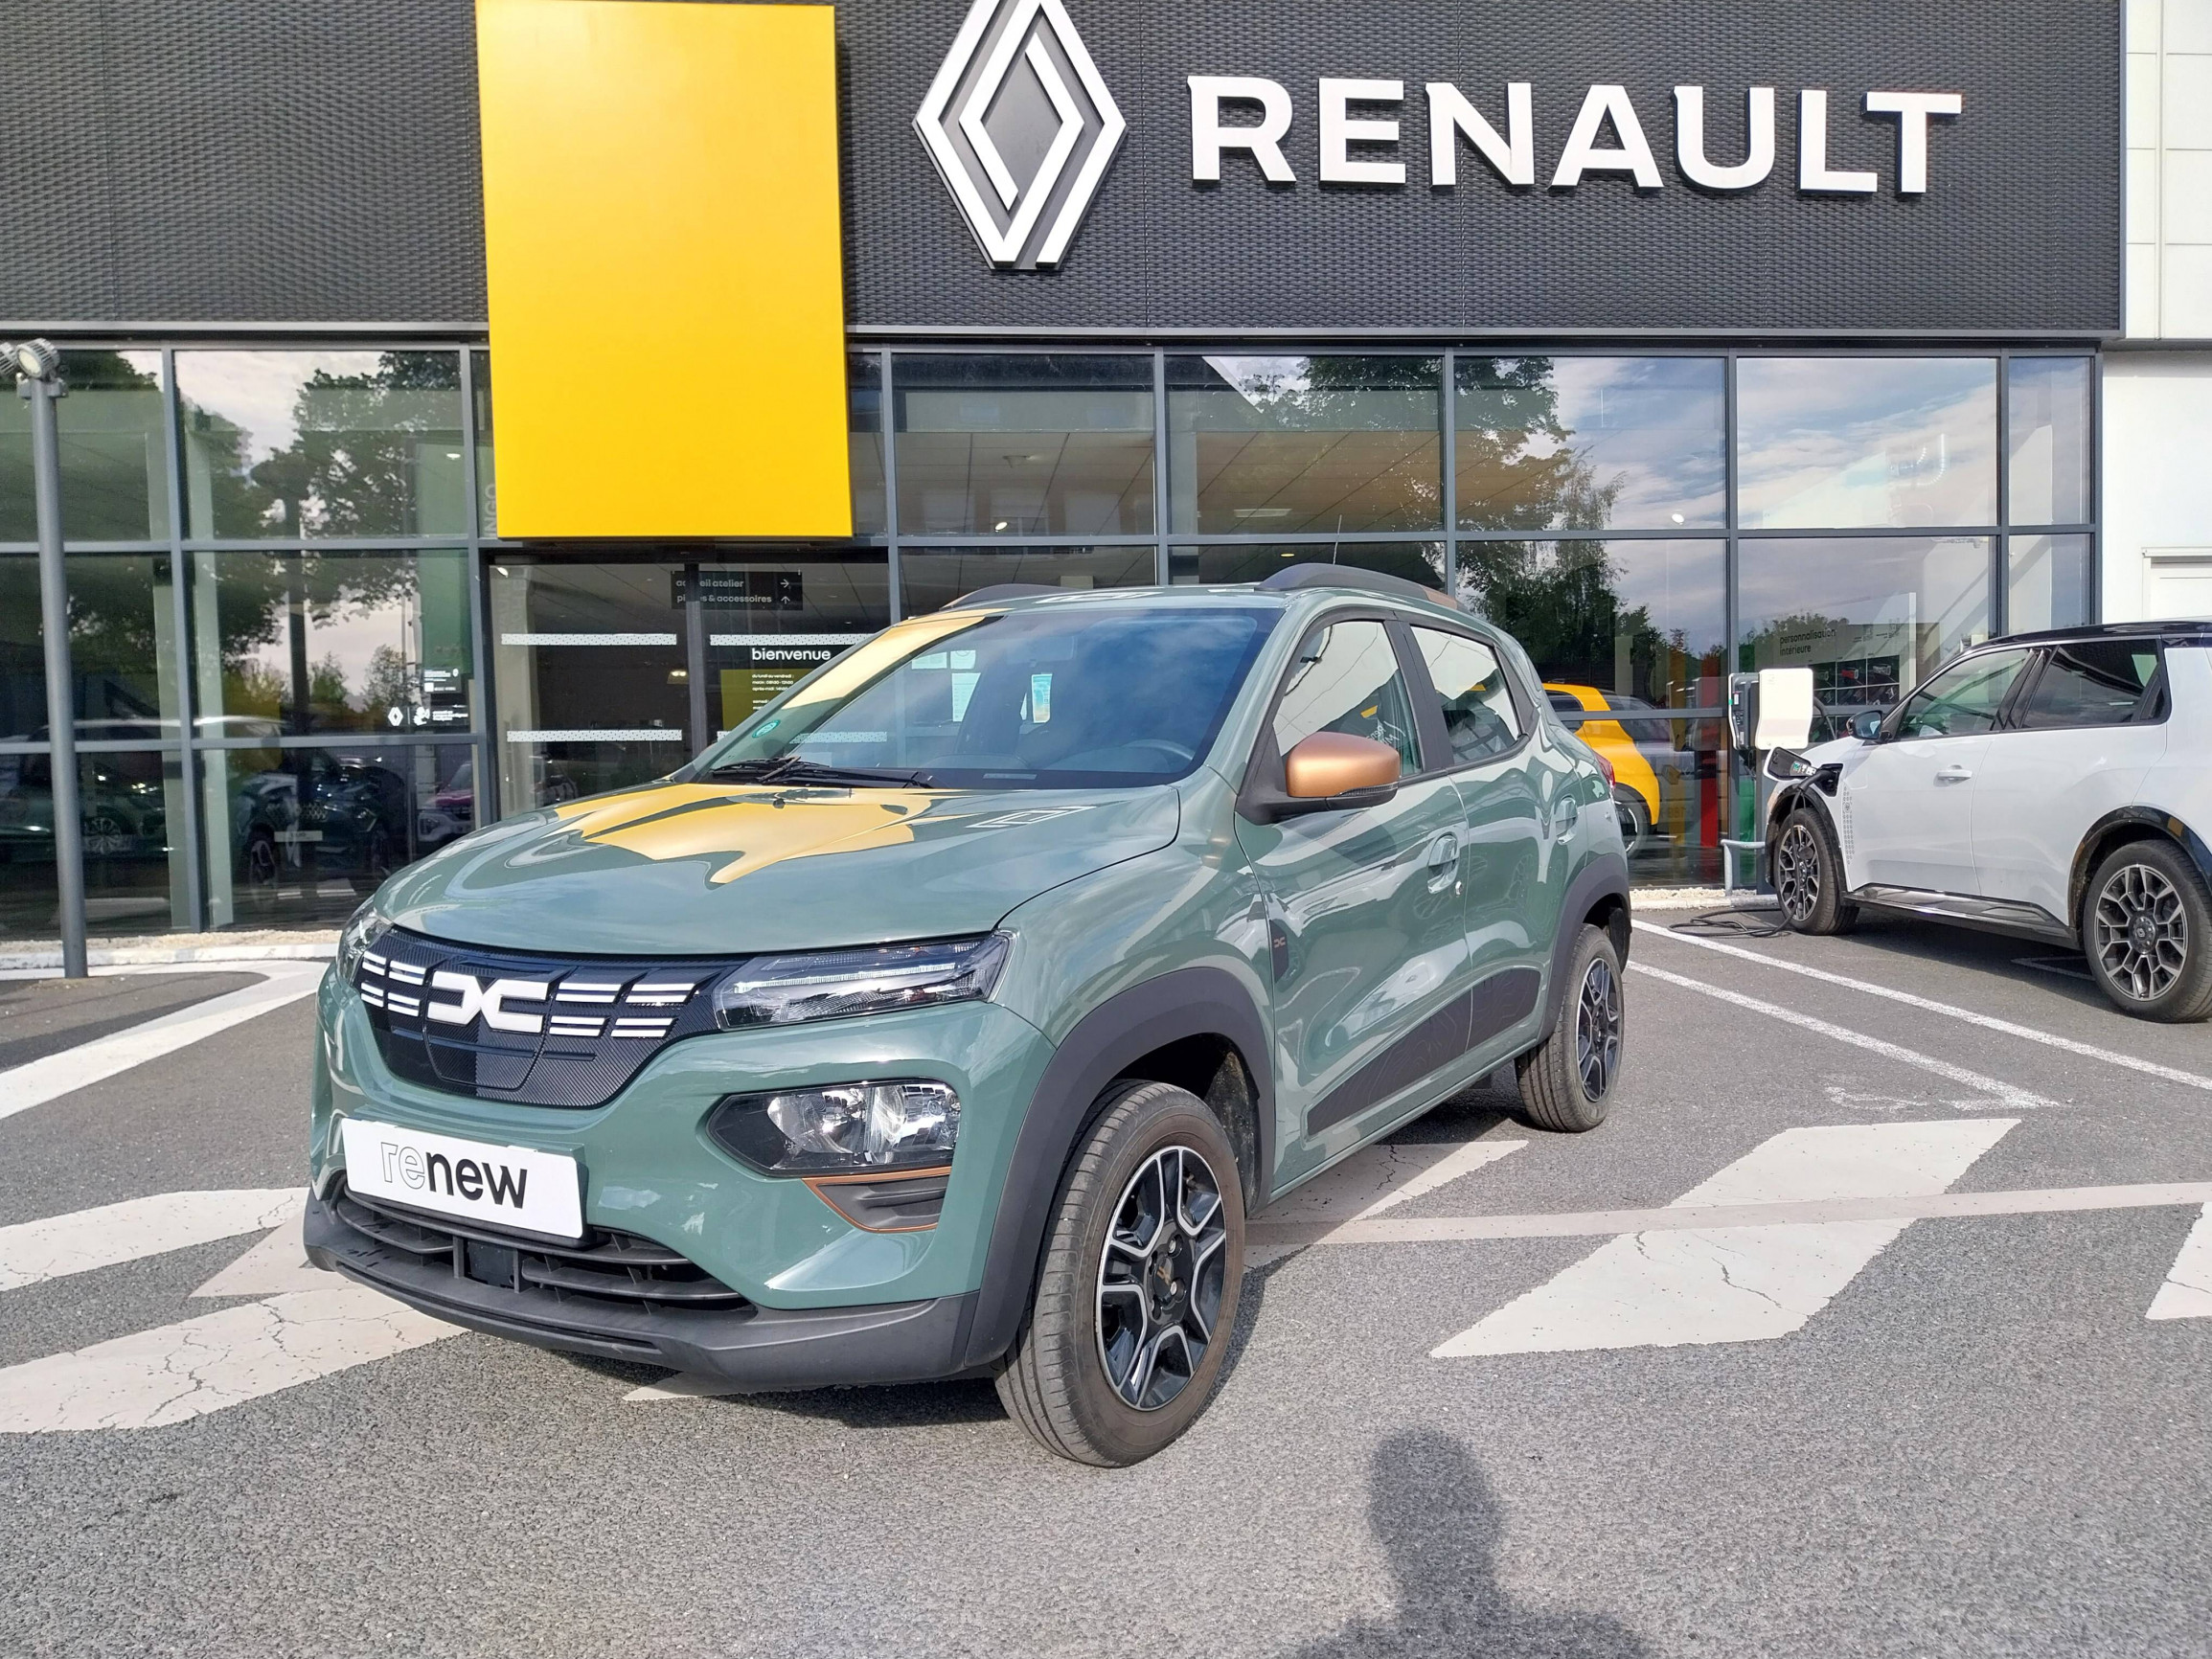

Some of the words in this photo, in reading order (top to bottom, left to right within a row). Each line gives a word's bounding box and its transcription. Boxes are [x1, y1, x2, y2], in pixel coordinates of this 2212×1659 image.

[1187, 76, 1963, 193] RENAULT
[675, 579, 712, 587] aceil
[712, 579, 744, 587] atelier
[677, 594, 708, 603] pis
[717, 594, 772, 602] accessoires
[1779, 628, 1836, 644] personnalisation
[751, 648, 832, 661] bienvenue
[380, 1142, 528, 1209] renew
